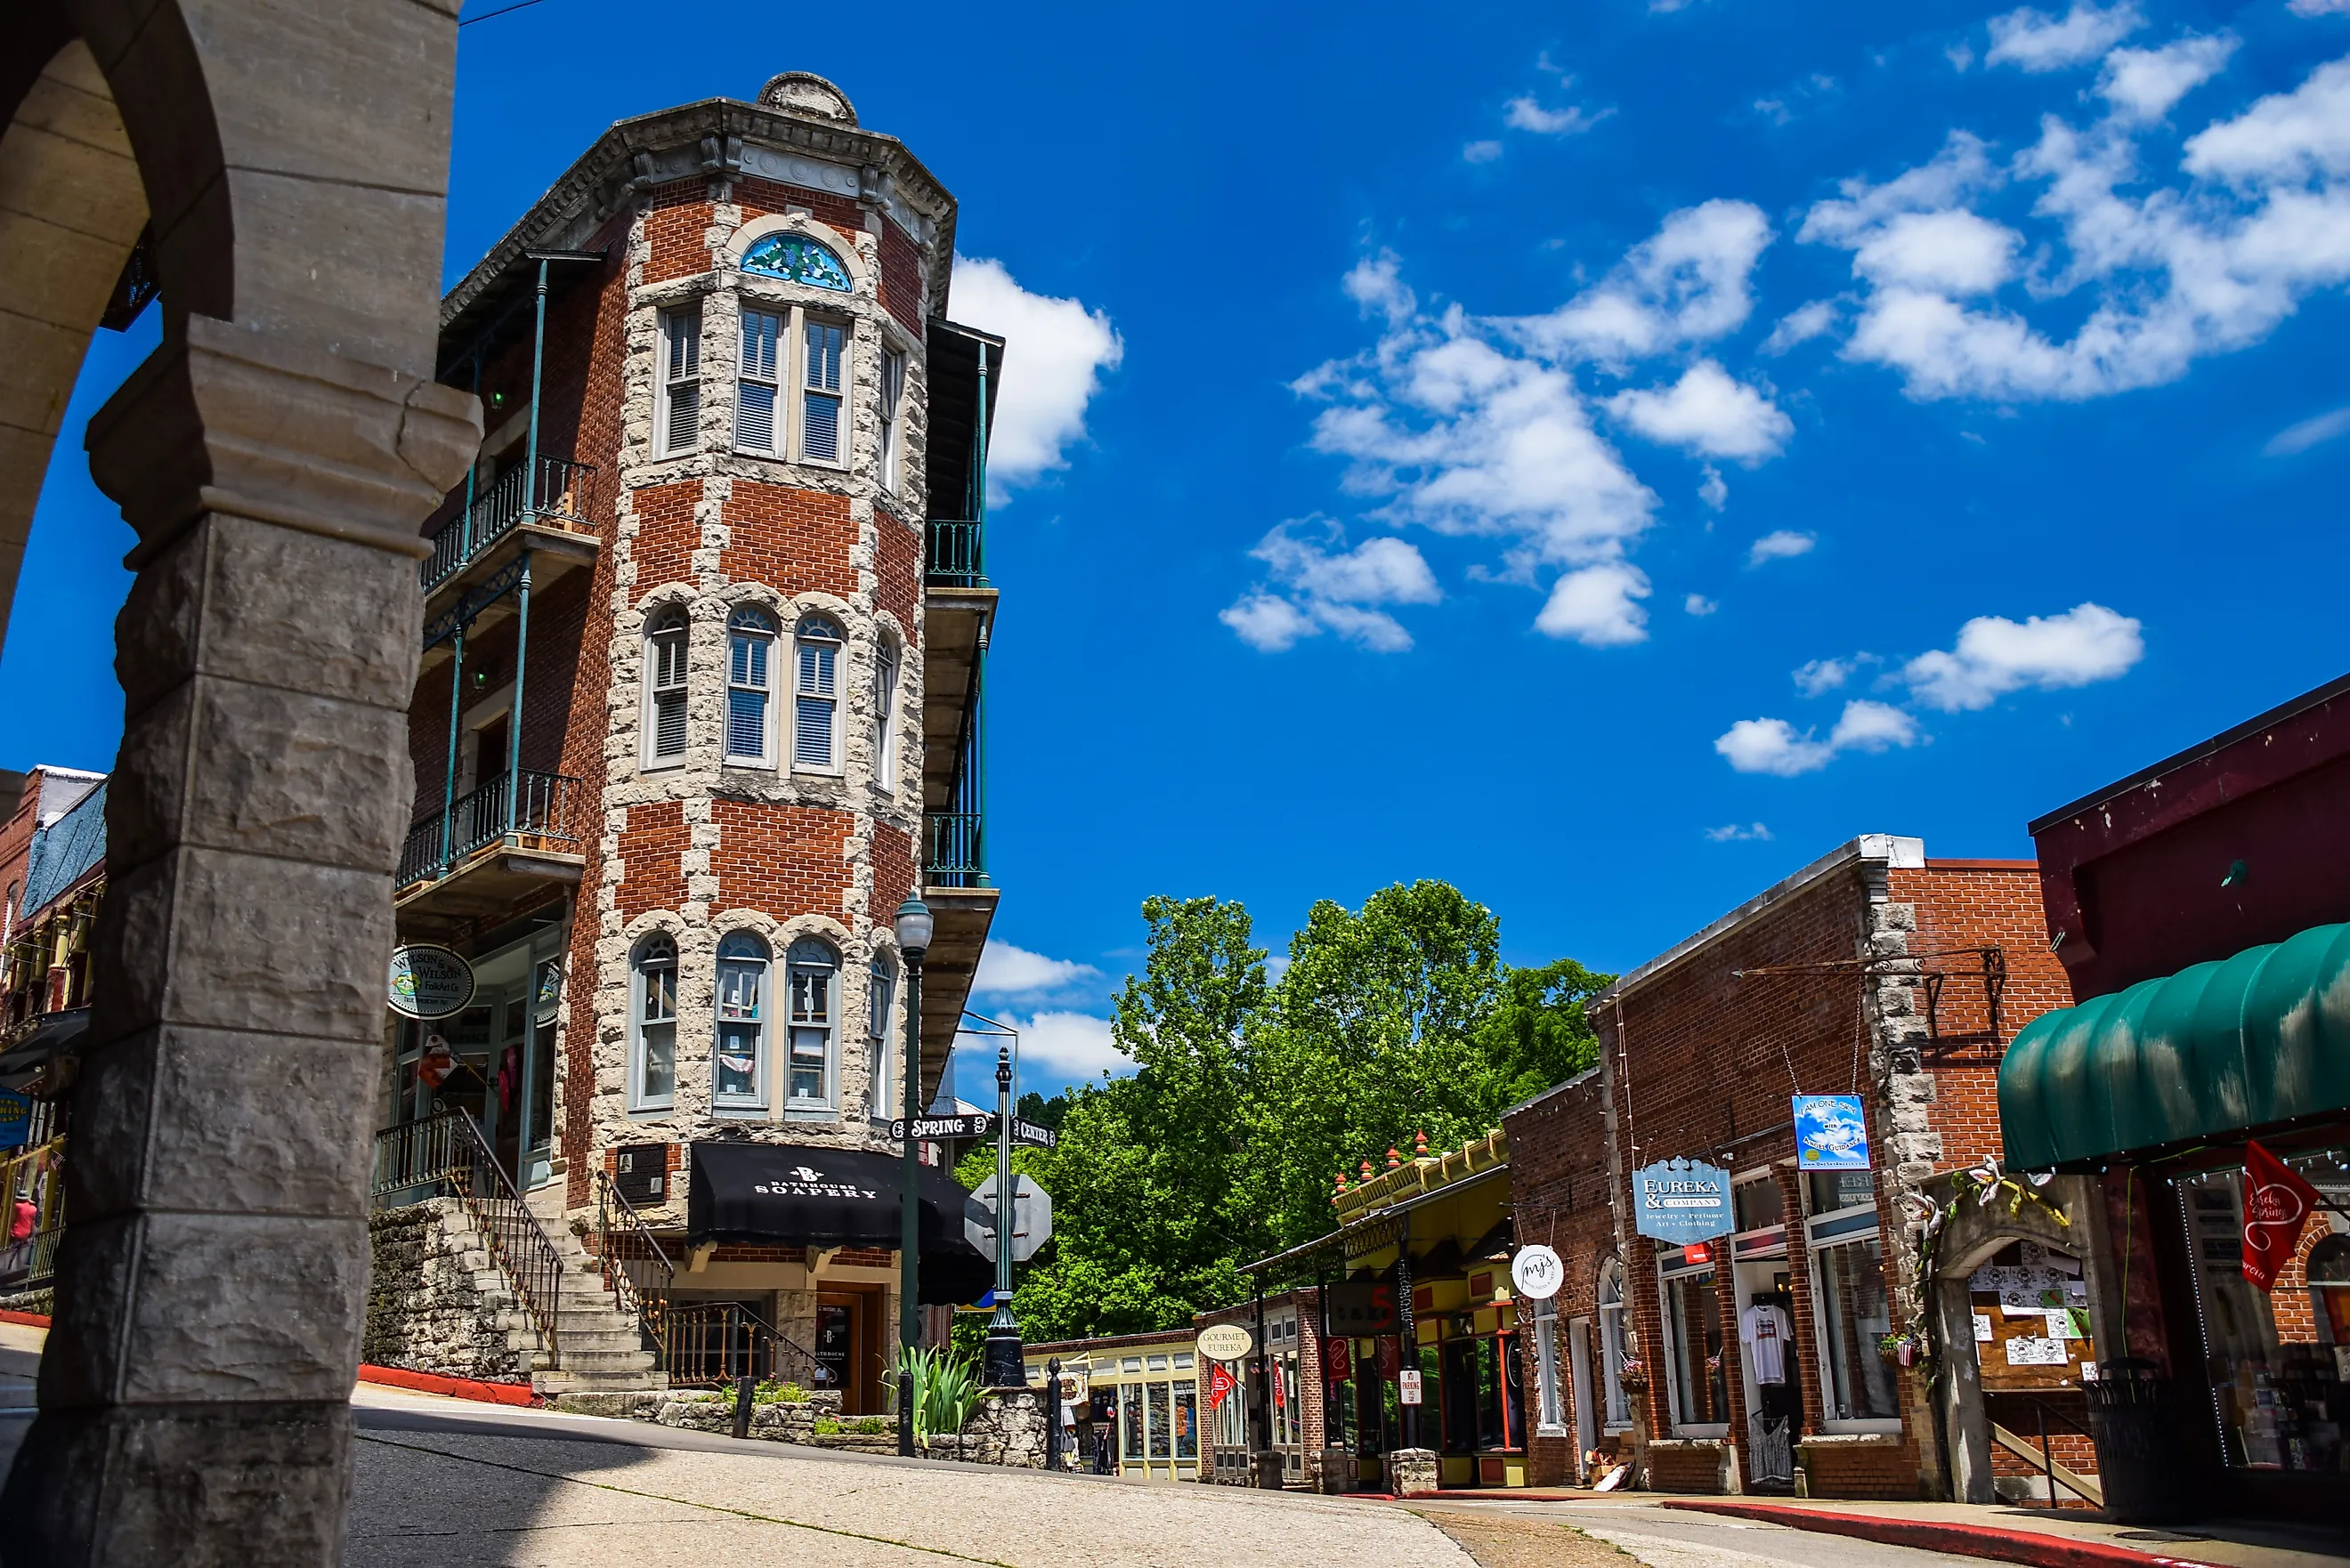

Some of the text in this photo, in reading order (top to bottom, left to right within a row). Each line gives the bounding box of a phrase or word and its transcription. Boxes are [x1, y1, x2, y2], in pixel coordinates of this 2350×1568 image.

[393, 954, 438, 970] WILSON
[417, 966, 461, 980] WILSON
[1804, 1103, 1817, 1113] AM
[1818, 1100, 1837, 1108] ONE
[912, 1119, 965, 1138] SPRING
[1020, 1123, 1049, 1145] CENTER
[1804, 1137, 1860, 1152] ANGEL GUIDANCE
[754, 1185, 877, 1199] SOAPERY
[771, 1181, 856, 1190] BATHHOUSE
[1644, 1179, 1721, 1193] EUREKA
[1645, 1193, 1719, 1209] & COMPANY
[2249, 1192, 2281, 1207] Eureka
[1372, 1285, 1395, 1329] 5
[1203, 1332, 1246, 1342] GOURMET
[1208, 1344, 1243, 1352] EUREKA
[1402, 1381, 1420, 1390] PARKING
